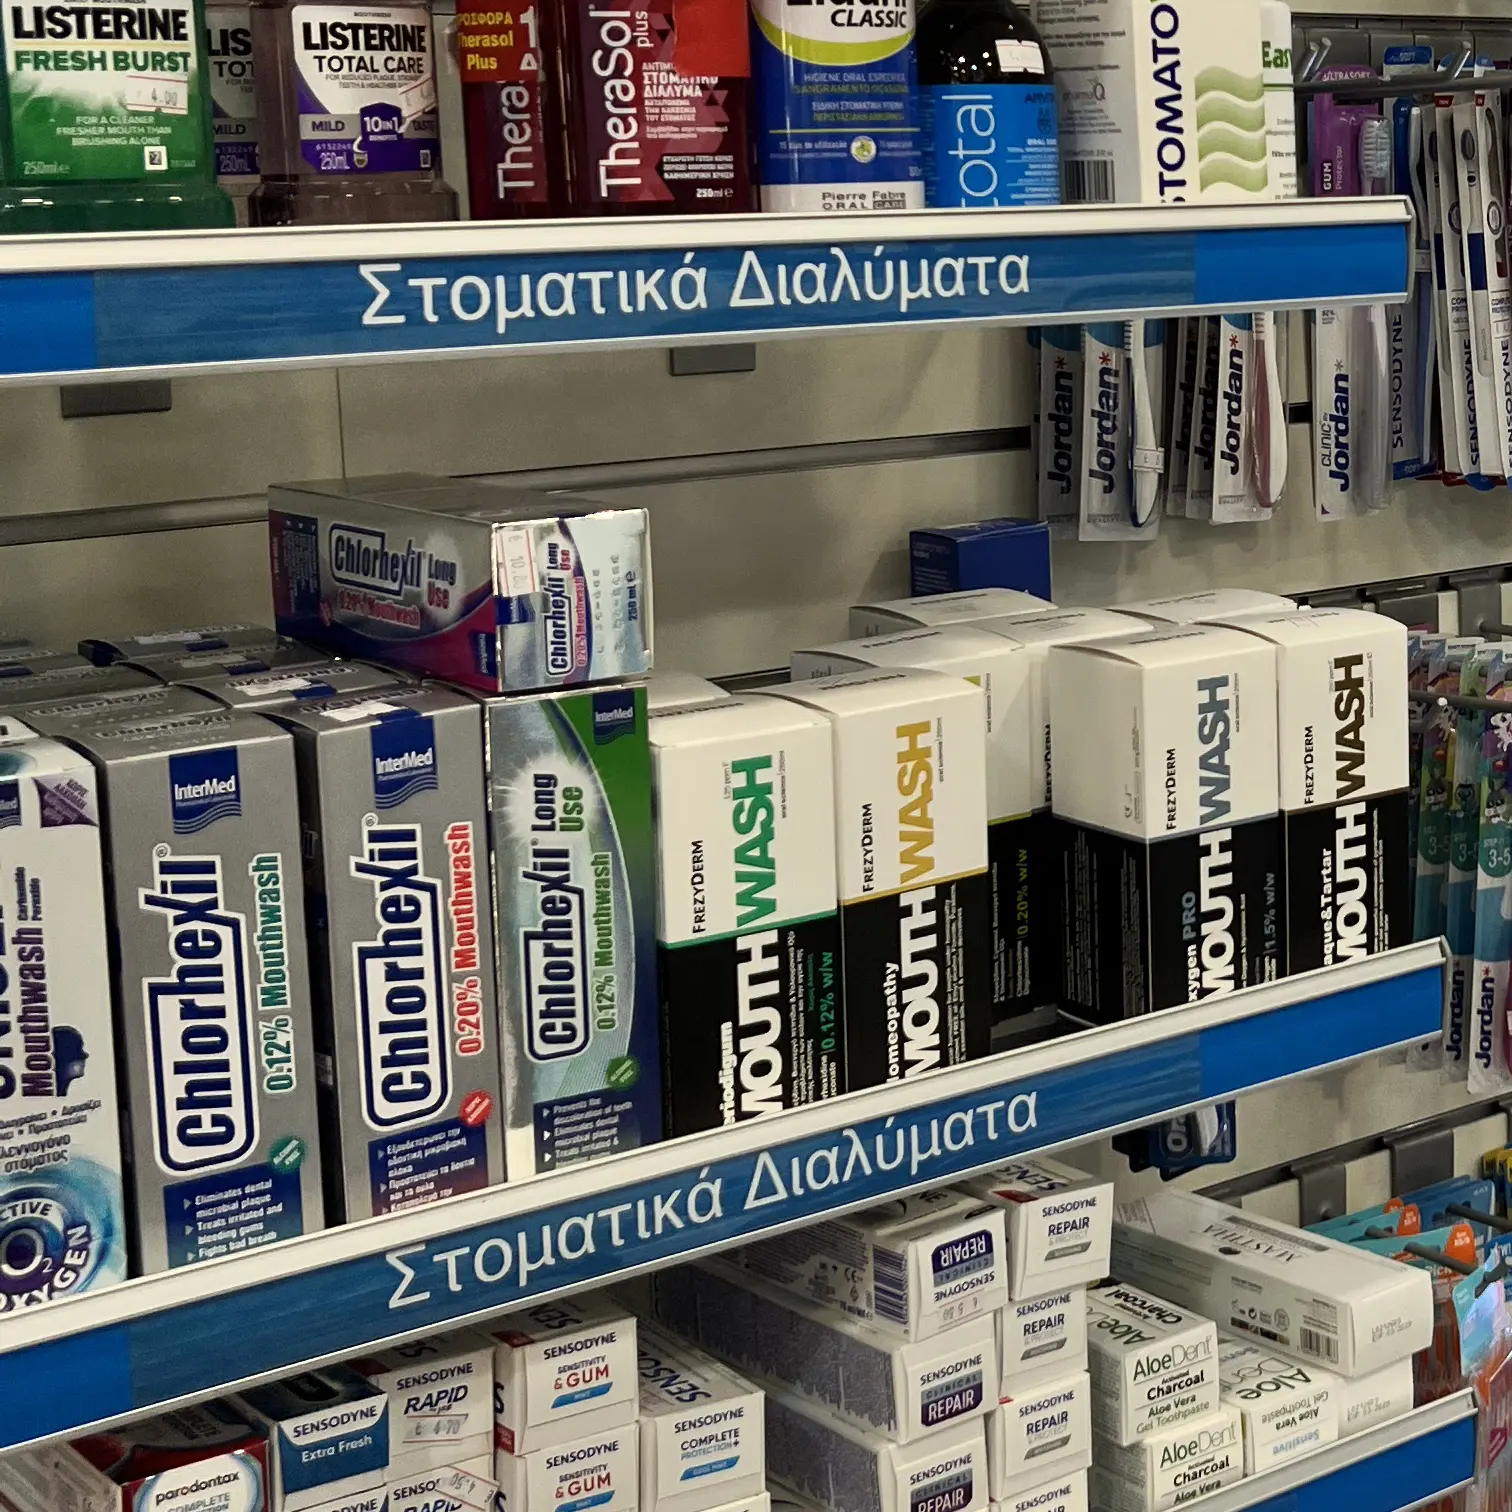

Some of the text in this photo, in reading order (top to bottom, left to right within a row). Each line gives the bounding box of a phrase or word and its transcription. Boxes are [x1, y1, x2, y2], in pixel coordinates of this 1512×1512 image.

[13, 5, 190, 41] LISTERINE
[302, 21, 428, 52] LISTERINE
[635, 10, 654, 48] plus
[830, 8, 908, 29] CLASSIC
[15, 49, 190, 74] FRESH BURST
[313, 55, 424, 75] TOTAL CARE
[466, 54, 498, 72] Plus
[592, 8, 642, 198] TheraSol
[643, 84, 703, 99] ΔΙΑΛΥΜΑ
[56, 126, 172, 136] FRESHER MOUTH THAN
[76, 116, 155, 125] FOR A CLEANER
[311, 119, 346, 134] MILD
[942, 92, 1000, 208] otal
[1323, 163, 1332, 191] GUM
[821, 190, 906, 202] Pierre Fabre
[358, 246, 1030, 334] Στοματικά Διαλύματα
[1392, 314, 1403, 449] SENSODYNE
[1089, 364, 1120, 494] Jordan
[1220, 348, 1244, 476] Jordan
[1321, 423, 1332, 467] CLINIC
[1329, 372, 1349, 491] Jordan
[547, 542, 559, 570] Long
[559, 549, 571, 572] Use
[544, 576, 566, 671] Chlorhexil
[1333, 653, 1366, 799] WASH
[375, 746, 433, 775] InterMed
[1197, 674, 1231, 826] WASH
[174, 775, 236, 800] InterMed
[531, 772, 557, 833] Long
[896, 719, 934, 885] WASH
[559, 786, 585, 832] Use
[731, 754, 776, 928] WASH
[1182, 890, 1197, 940] PRO
[444, 822, 482, 1056] 0.20% Mouthwash
[591, 852, 616, 1031] 0.12% Mouthwash
[251, 853, 297, 1093] Mouthwash 0.12%
[12, 926, 55, 1099] Mouthwash
[820, 986, 837, 1052] 0.12%
[1475, 975, 1495, 1069] Jordan
[385, 1164, 723, 1310] Στοματικά
[743, 1089, 1038, 1211] Διαλύματα
[1042, 1195, 1097, 1218] SENSODYNE
[1047, 1215, 1090, 1237] REPAIR
[544, 1331, 616, 1361] SENSODYNE
[1132, 1336, 1214, 1382] AloeDent
[566, 1364, 610, 1389] GUM
[1147, 1370, 1205, 1401] Charcoal
[403, 1384, 469, 1415] RAPID
[927, 1390, 975, 1422] REPAIR
[293, 1405, 378, 1439] SENSODYNE
[675, 1407, 745, 1434] SENSODYNE
[301, 1434, 373, 1464] Extra Fresh
[155, 1469, 240, 1505] parodontax
